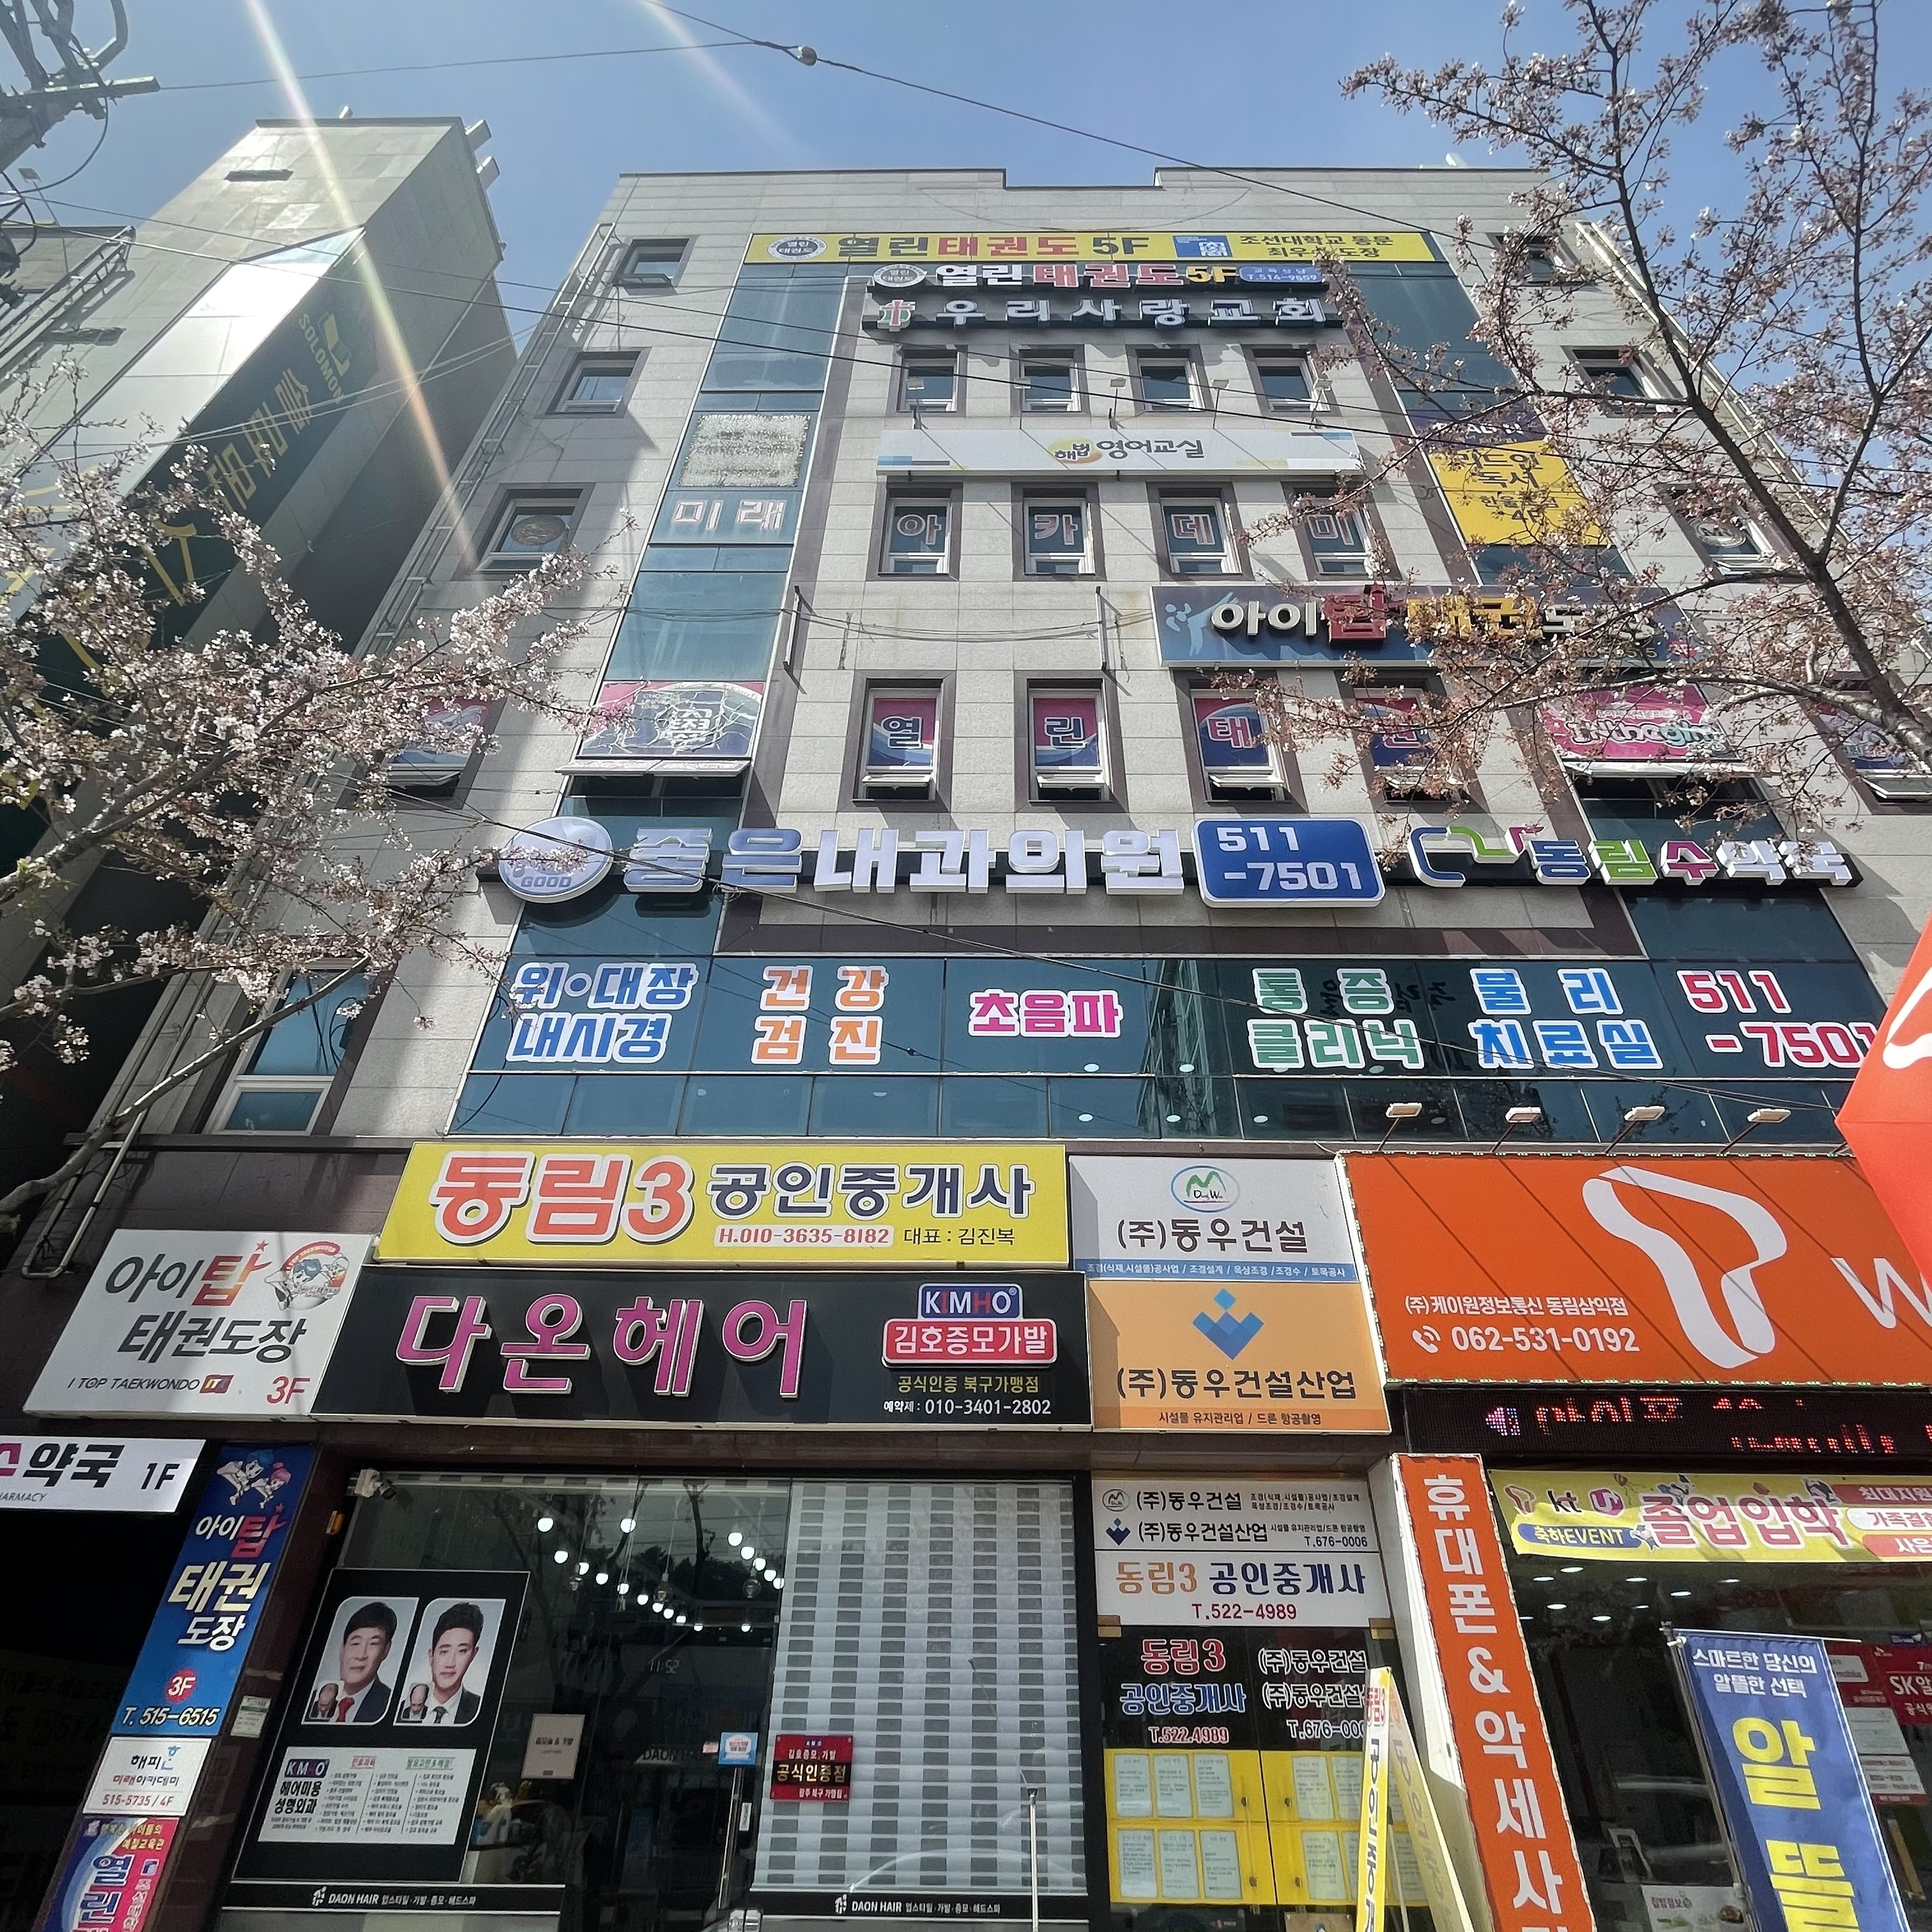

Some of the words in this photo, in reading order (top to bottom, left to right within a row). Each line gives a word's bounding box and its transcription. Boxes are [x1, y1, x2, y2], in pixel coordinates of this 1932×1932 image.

[1092, 236, 1149, 256] 5F
[298, 312, 345, 404] SOLOMON
[1054, 442, 1090, 461] 해법
[1096, 439, 1206, 459] 영어교실
[1218, 827, 1300, 852] 511
[623, 827, 1184, 895] 좋은내과의원
[519, 876, 573, 888] GOOD
[1223, 861, 1363, 891] -7501
[1676, 969, 1792, 1014] 511
[969, 988, 1124, 1038] 초음파
[506, 1013, 672, 1064] 내시경
[1247, 1019, 1425, 1070] 클리닉
[1468, 1019, 1664, 1070] 치료실
[429, 1150, 695, 1245] 동림3
[705, 1161, 1036, 1221] 공인중개사
[718, 1227, 890, 1245] H.010-3635-8182
[903, 1227, 942, 1245] 대표
[957, 1227, 1016, 1246] 김진복
[1117, 1217, 1308, 1254] (주)동우건설
[104, 1240, 273, 1307] 아이탑
[924, 1289, 1012, 1314] KIMHO
[1545, 1296, 1629, 1317] 동림삼익점
[118, 1310, 307, 1365] 태권도장
[395, 1292, 808, 1401] 다온헤어
[894, 1324, 1048, 1356] 김호증모가발
[1451, 1325, 1640, 1353] 062-531-0192
[110, 1377, 201, 1392] TAEKWONDO
[266, 1376, 311, 1405] 3F
[897, 1374, 958, 1393] 공식인증
[963, 1374, 1039, 1394] 북구가맹점
[1117, 1367, 1357, 1400] (주)동우건설산업
[924, 1399, 1052, 1416] 010-3401-2802
[1159, 1411, 1189, 1425] 시설물
[1193, 1412, 1245, 1425] 유지관리업
[1257, 1412, 1278, 1425] 드론
[1280, 1413, 1322, 1426] 항공촬영
[140, 1462, 181, 1491] 1F
[1136, 1490, 1243, 1512] (주)동우건설
[194, 1503, 289, 1558] 아이탑
[1138, 1522, 1269, 1544] (주)동우건설산업
[1639, 1493, 1851, 1548] 졸업입학
[1303, 1536, 1368, 1548] T.676-0006
[167, 1561, 271, 1614] 태권
[1116, 1561, 1198, 1595] 동림3
[1208, 1561, 1366, 1595] 공인중개사
[1192, 1603, 1298, 1620] T.522-4989
[177, 1614, 248, 1652] 도장
[1692, 1648, 1759, 1671] 스마트한
[1763, 1651, 1818, 1674] 당신의
[166, 1675, 197, 1697] 3F
[1119, 1682, 1246, 1716] 공인중개사
[1261, 1682, 1367, 1710] (주)동우건설
[1770, 1676, 1807, 1699] 선택
[138, 1706, 221, 1727] 515-6515
[1285, 1719, 1366, 1740] T.676-000
[776, 1763, 847, 1783] 공식인증점
[102, 1793, 151, 1806] 515-5735
[279, 1780, 323, 1797] 헤어미용
[274, 1797, 318, 1814] 성형외과
[328, 1893, 355, 1905] DAON
[355, 1893, 379, 1906] HAIR
[851, 1900, 878, 1913] DAON
[880, 1901, 903, 1913] HAIR
